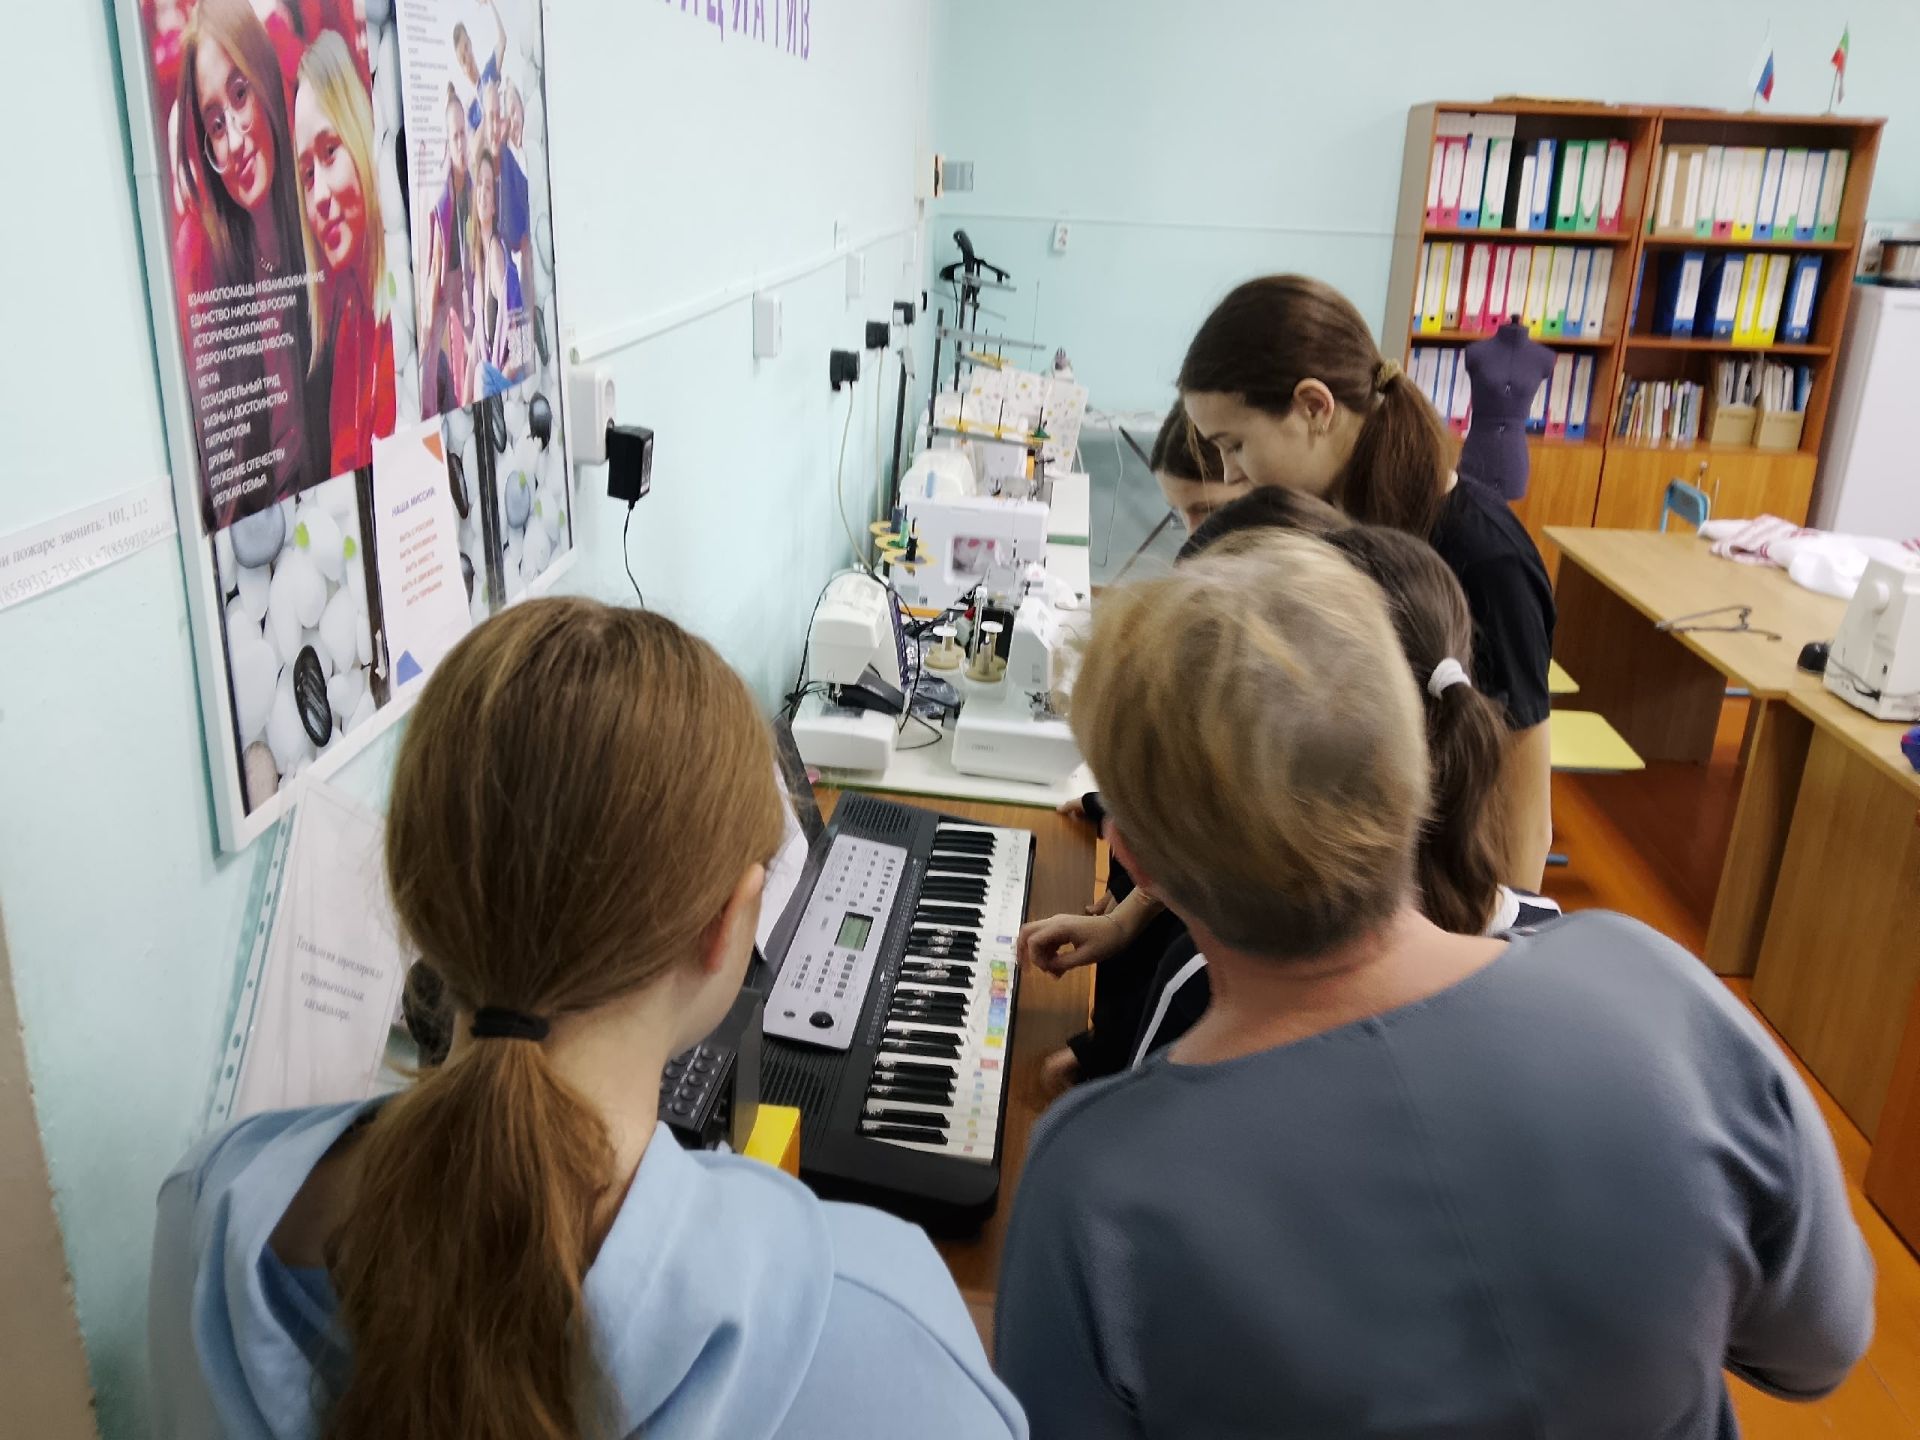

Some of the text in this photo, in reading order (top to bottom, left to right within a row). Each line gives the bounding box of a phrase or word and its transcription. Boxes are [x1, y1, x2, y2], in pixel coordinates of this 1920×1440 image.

[188, 283, 255, 307] ВЗАИМОПОМОЩЬ
[256, 281, 262, 293] И
[191, 295, 297, 328] ЕДИНСТВО НАРОДОВ РОССИИ
[193, 318, 279, 348] ИСТОРИЧЕСКАЯ ПАМЯТЬ
[196, 333, 295, 371] ДОБРО И СПРАВЕДЛИВОСТЬ
[198, 372, 220, 389] МЕЧТА
[200, 374, 280, 410] СОЗИДАТЕЛЬНЫЙ ТРУД
[203, 391, 288, 430] ЖИЗНЬ И ДОСТОИНСТВО
[205, 422, 251, 449] ПАТРИОТИЗМ
[208, 448, 235, 471] ДРУЖБА
[210, 448, 285, 488] СЛУЖЕНИЕ ОТЕЧЕСТВУ
[212, 474, 267, 507] КРЕПКАЯ СЕМЬЯ
[391, 500, 409, 517] НАША
[13, 538, 56, 563] пожаре
[60, 519, 104, 545] звонить:
[109, 507, 130, 527] 101,
